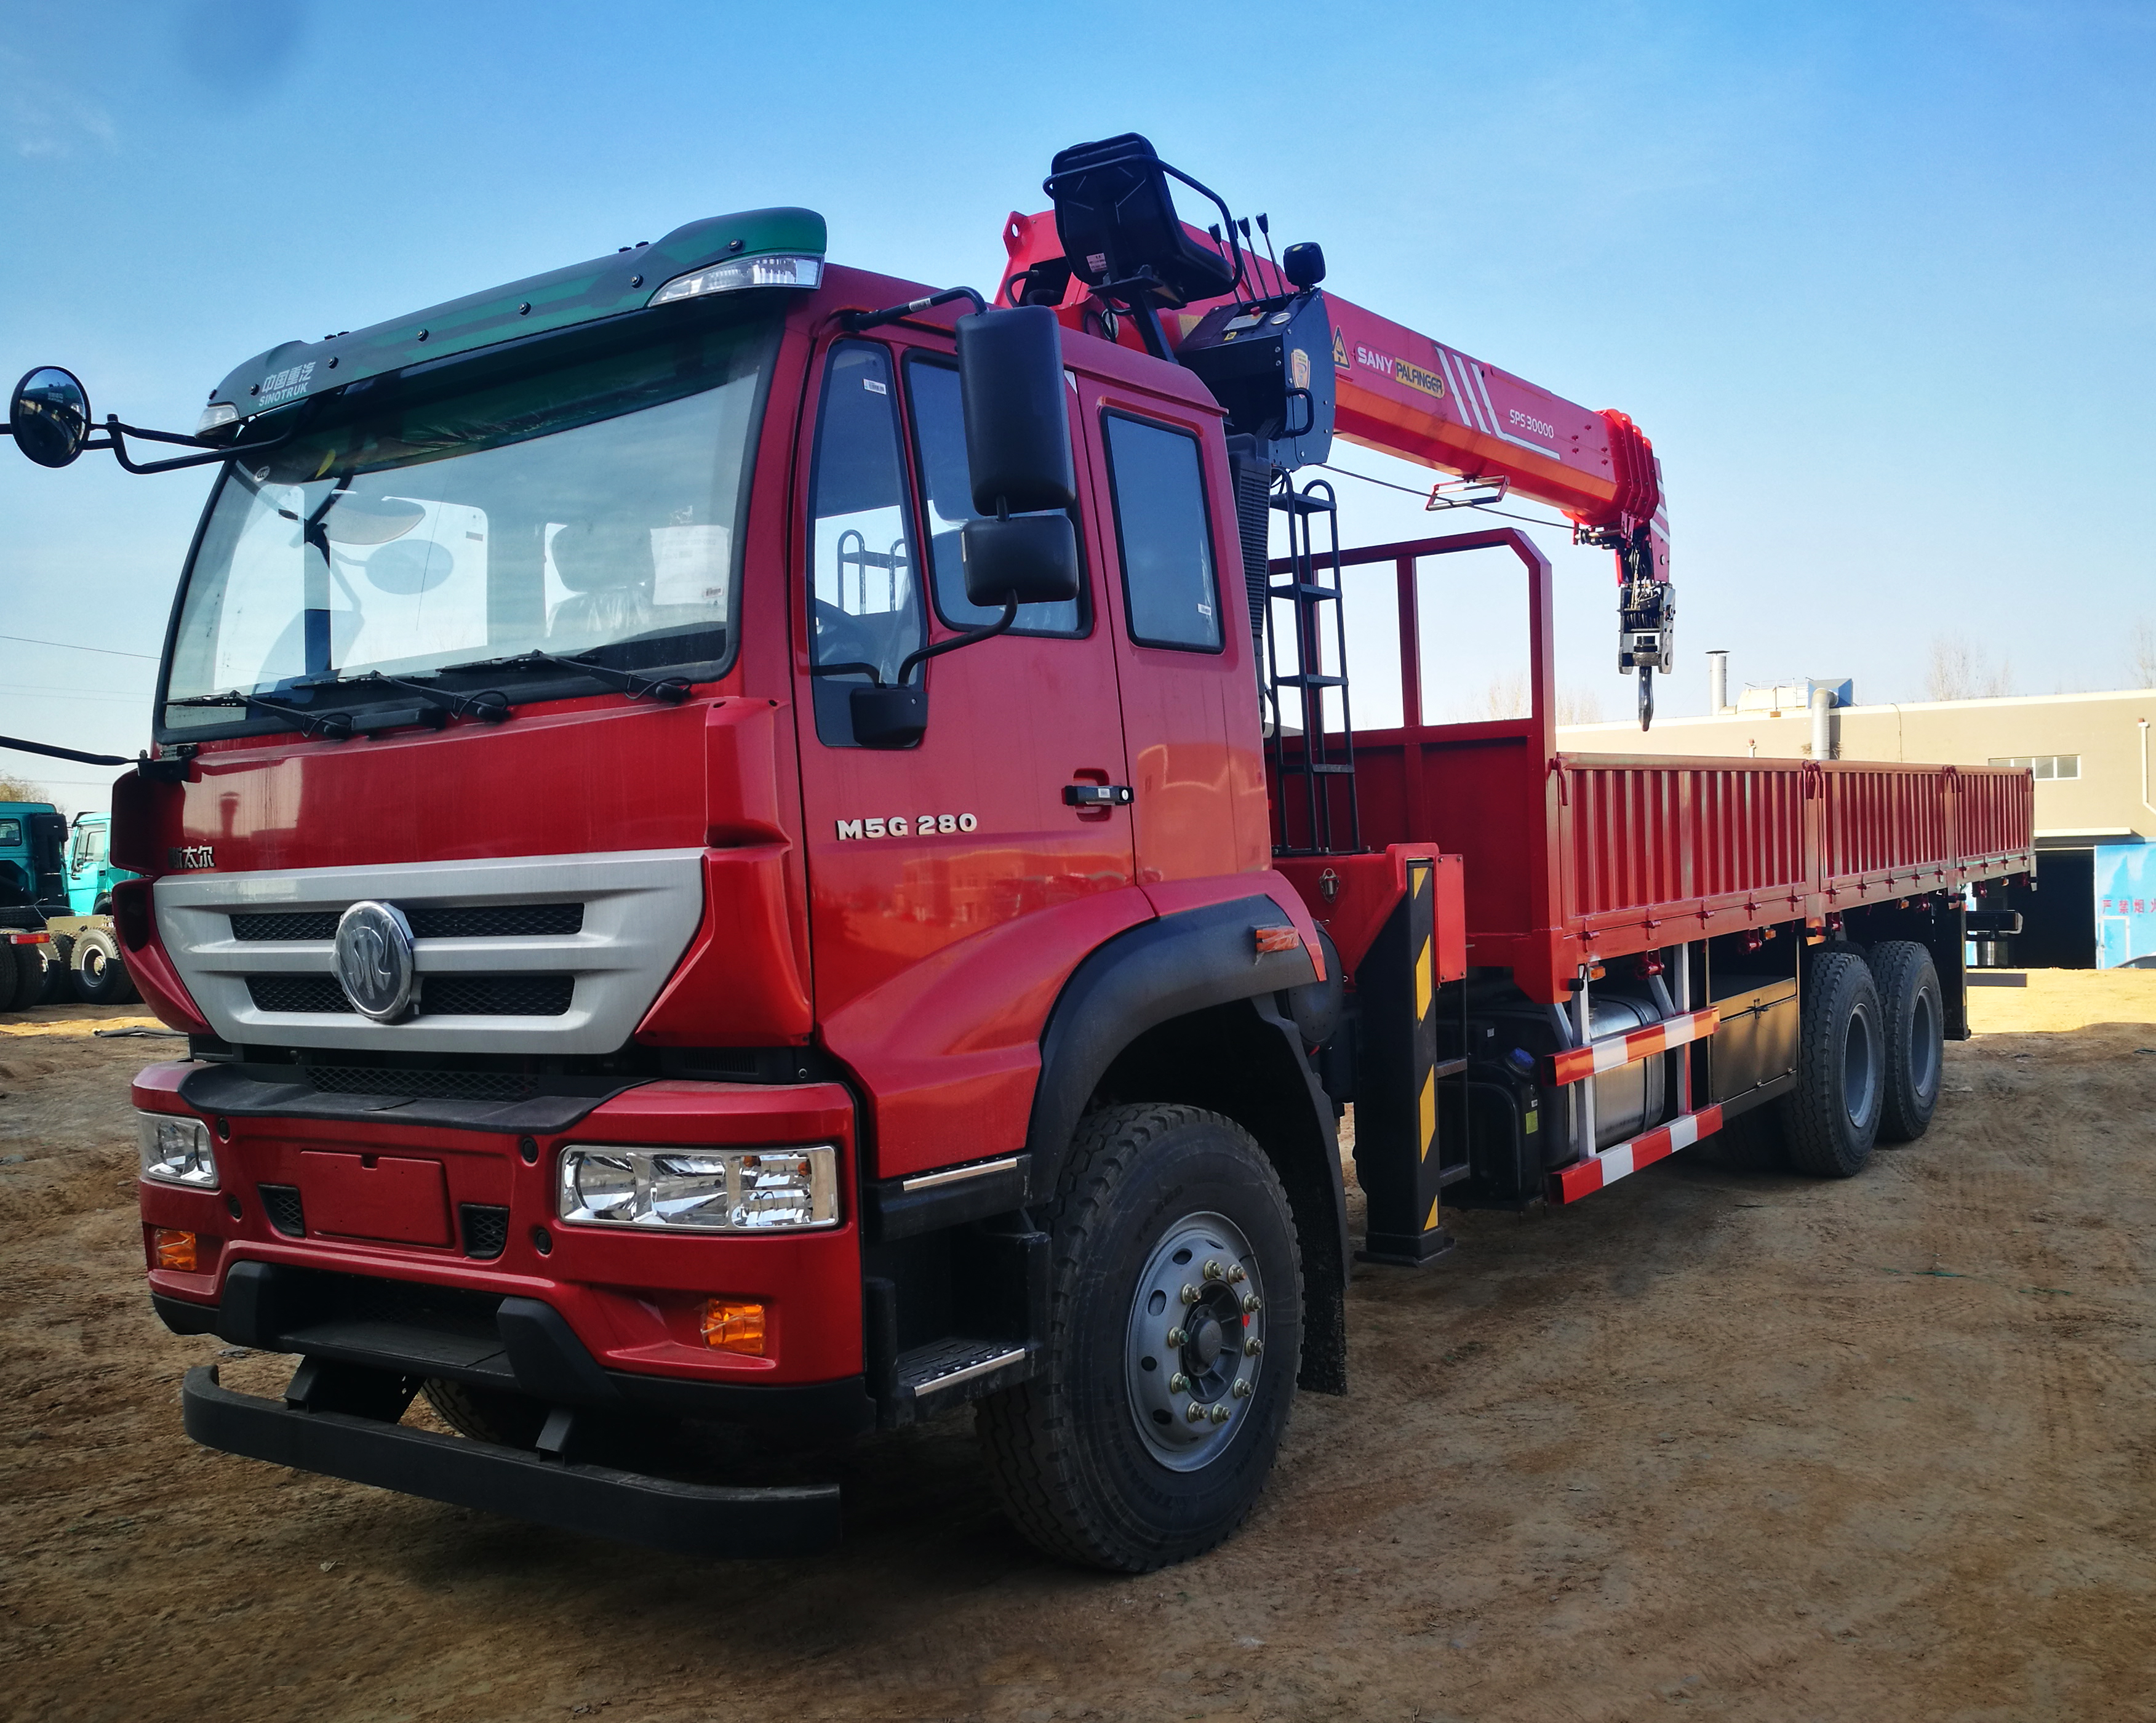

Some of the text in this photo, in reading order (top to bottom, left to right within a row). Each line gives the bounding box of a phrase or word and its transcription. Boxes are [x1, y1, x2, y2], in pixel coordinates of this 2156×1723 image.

[262, 361, 316, 394] 中国重汽
[1357, 346, 1443, 395] SANY PALFINGER
[258, 382, 308, 407] SINOTRUK
[1509, 409, 1554, 439] SPS 30000
[836, 813, 978, 841] M5G 280
